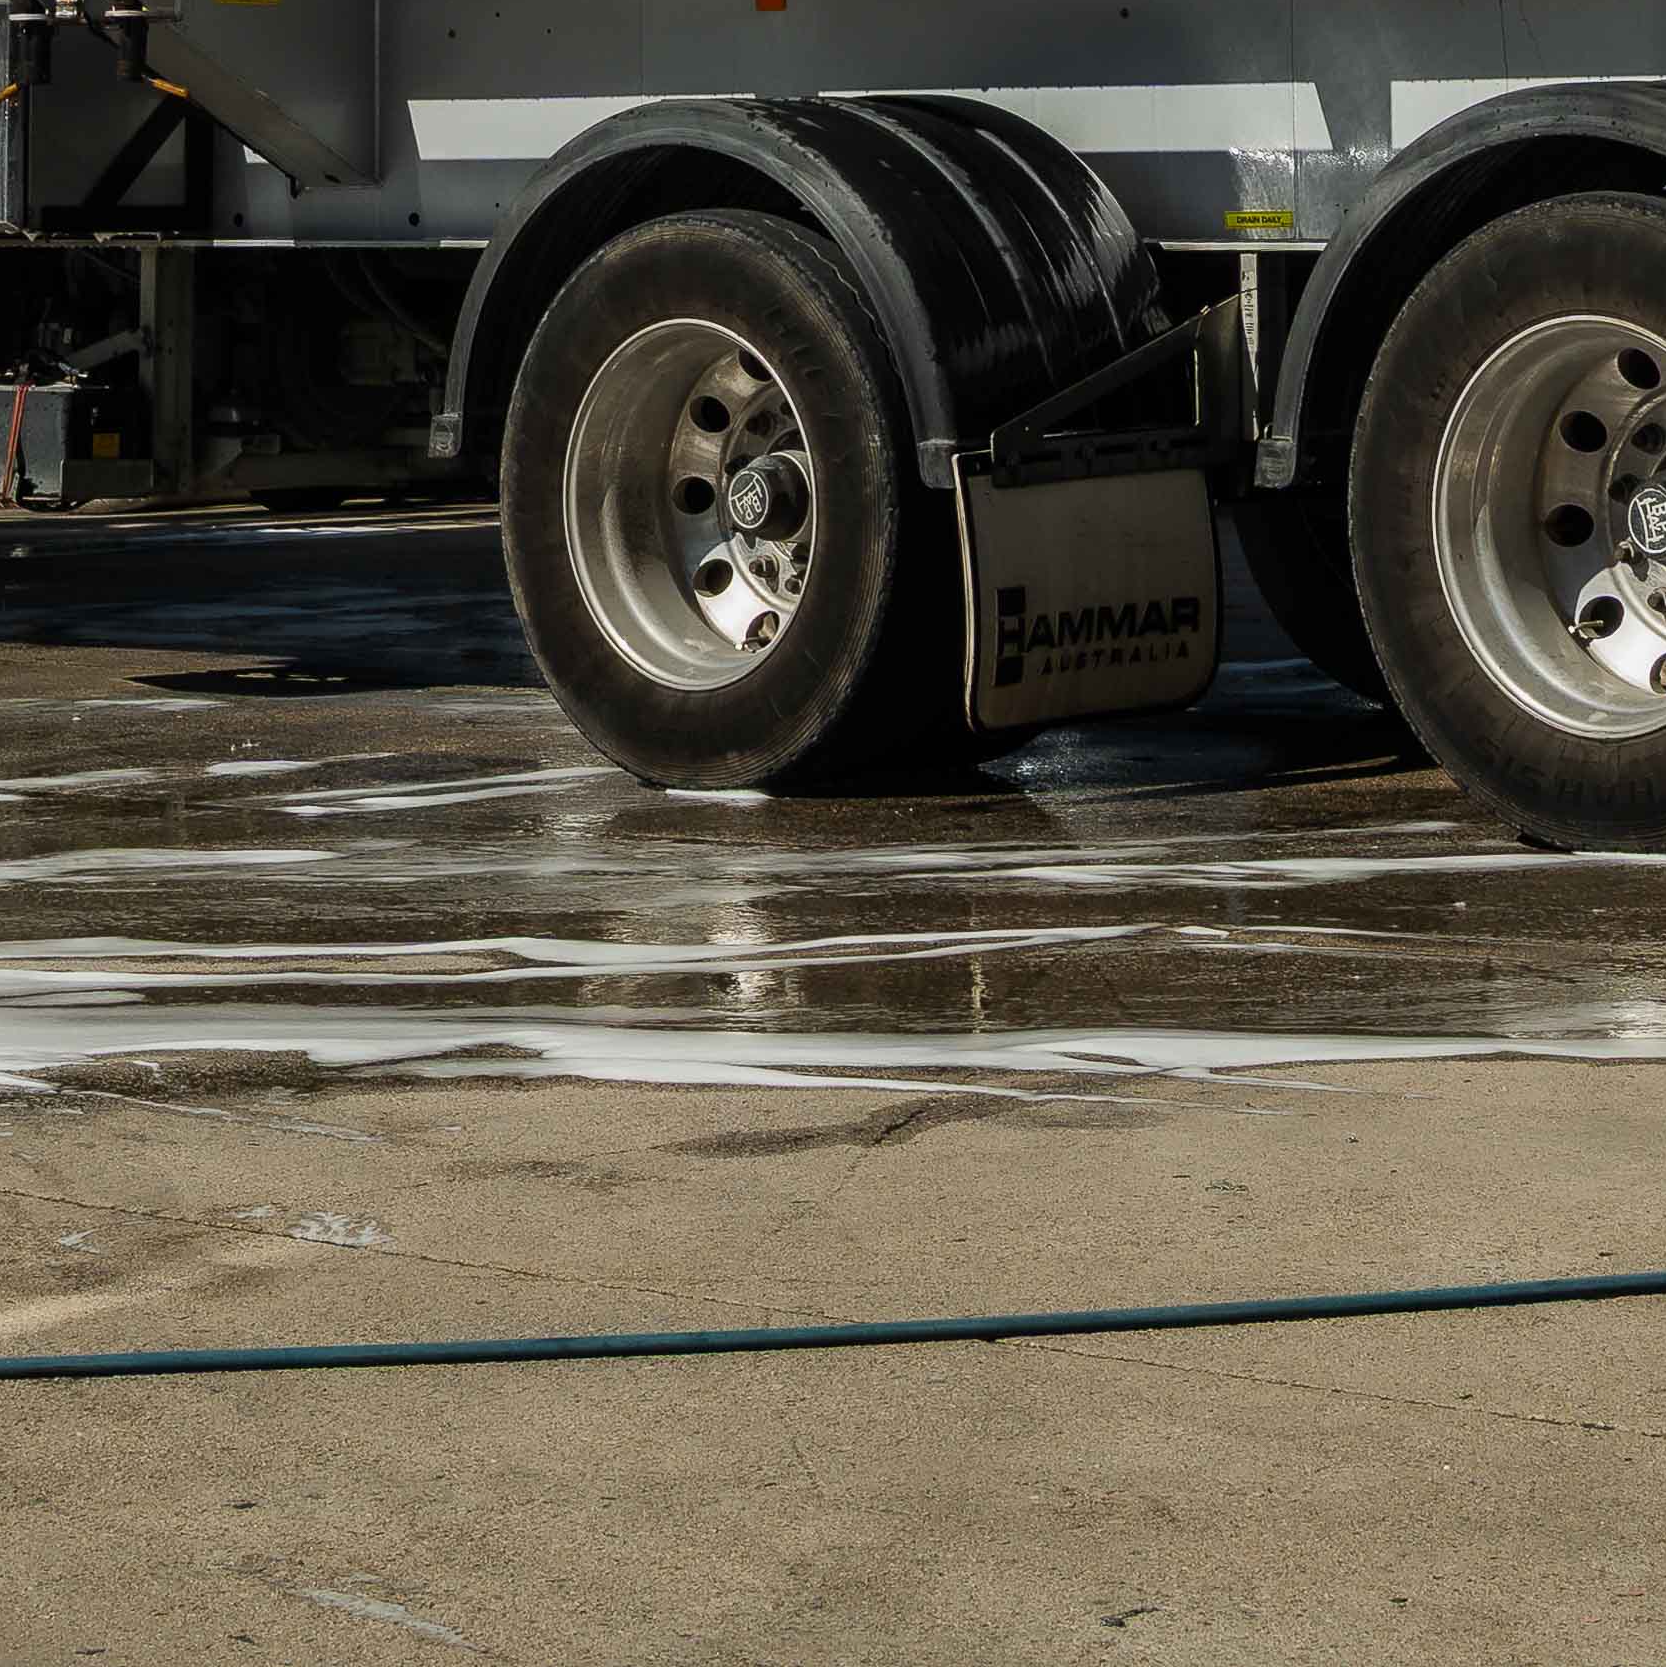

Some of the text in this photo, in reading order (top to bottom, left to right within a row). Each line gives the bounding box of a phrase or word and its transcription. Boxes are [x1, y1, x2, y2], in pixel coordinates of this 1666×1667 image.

[1236, 216, 1281, 224] DRAIN DAILY
[997, 595, 1201, 659] HAMMAR
[1037, 639, 1191, 676] AUSTRALIA
